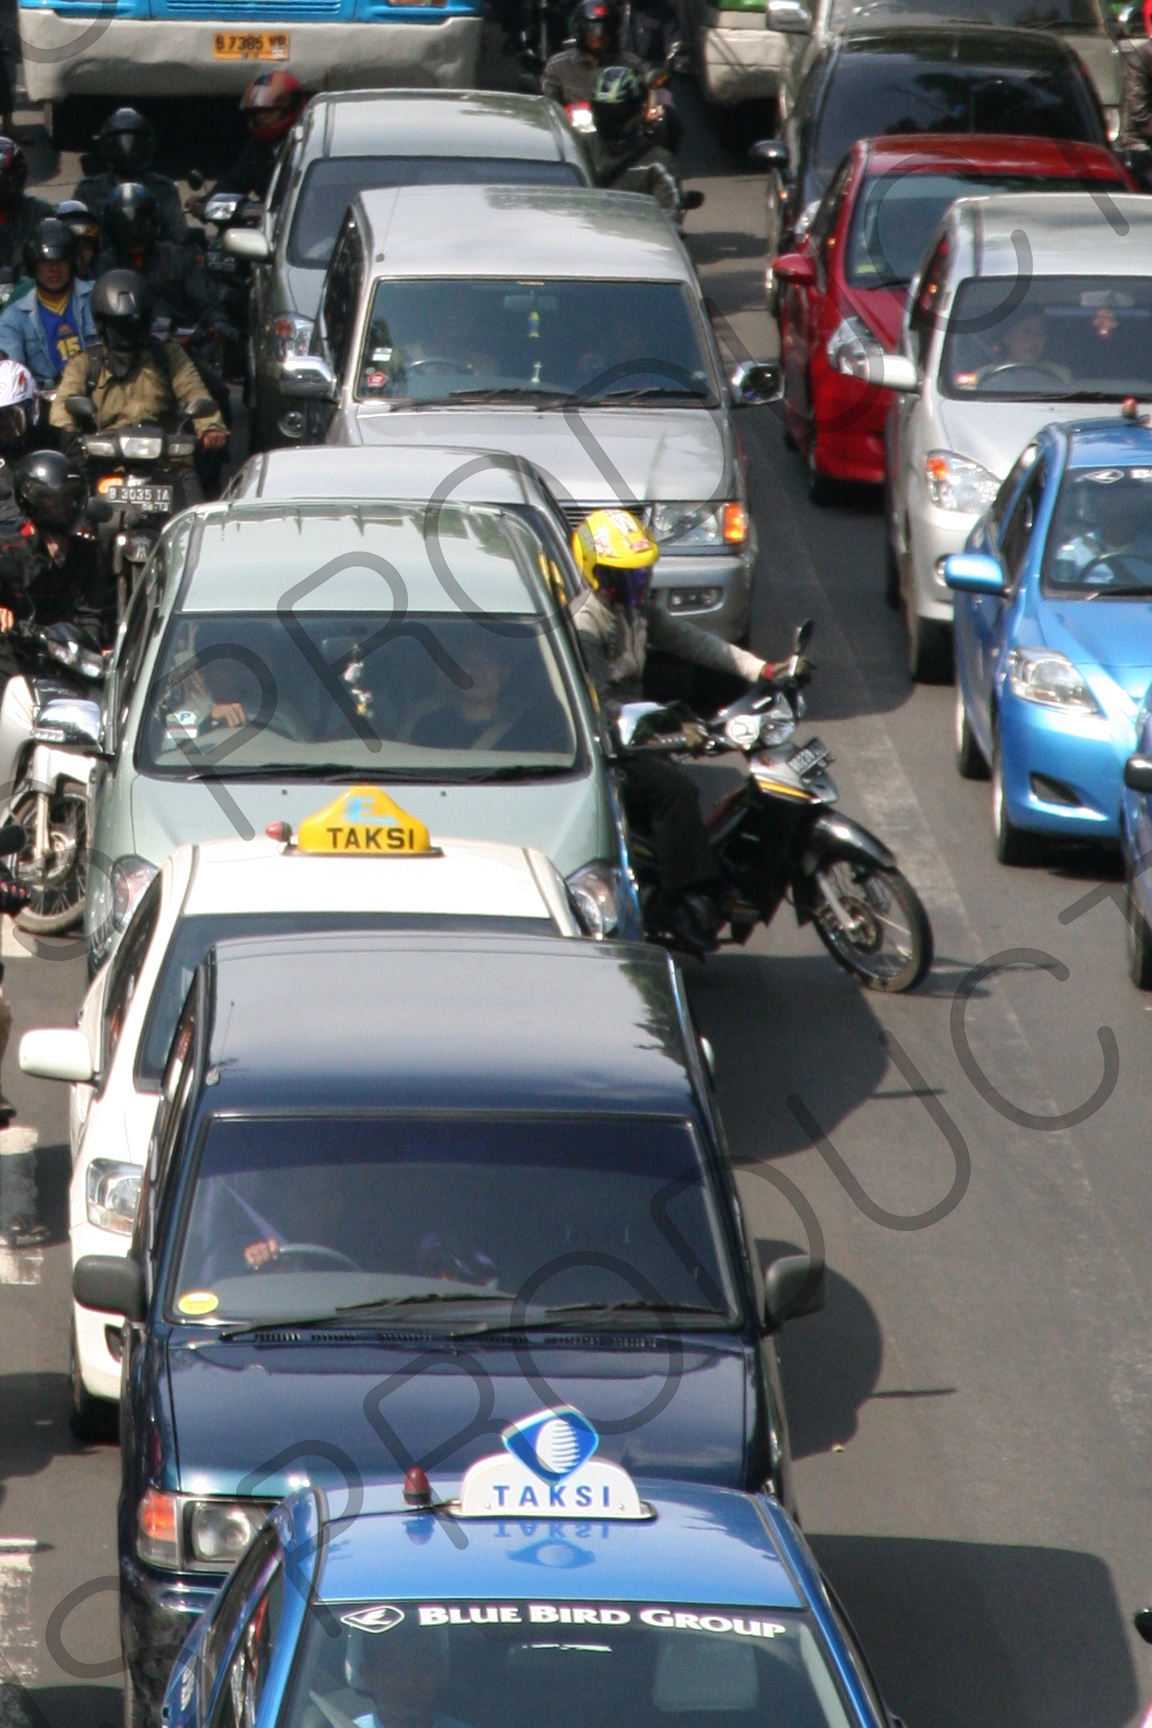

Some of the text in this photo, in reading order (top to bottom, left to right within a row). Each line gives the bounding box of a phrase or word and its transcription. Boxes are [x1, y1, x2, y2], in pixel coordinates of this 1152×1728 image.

[57, 336, 81, 361] 15
[109, 488, 117, 500] B
[121, 488, 152, 501] 3035
[327, 827, 415, 850] TAKSI
[493, 1485, 610, 1508] TAKSI
[418, 1604, 786, 1639] BLUE BIRD GROUP
